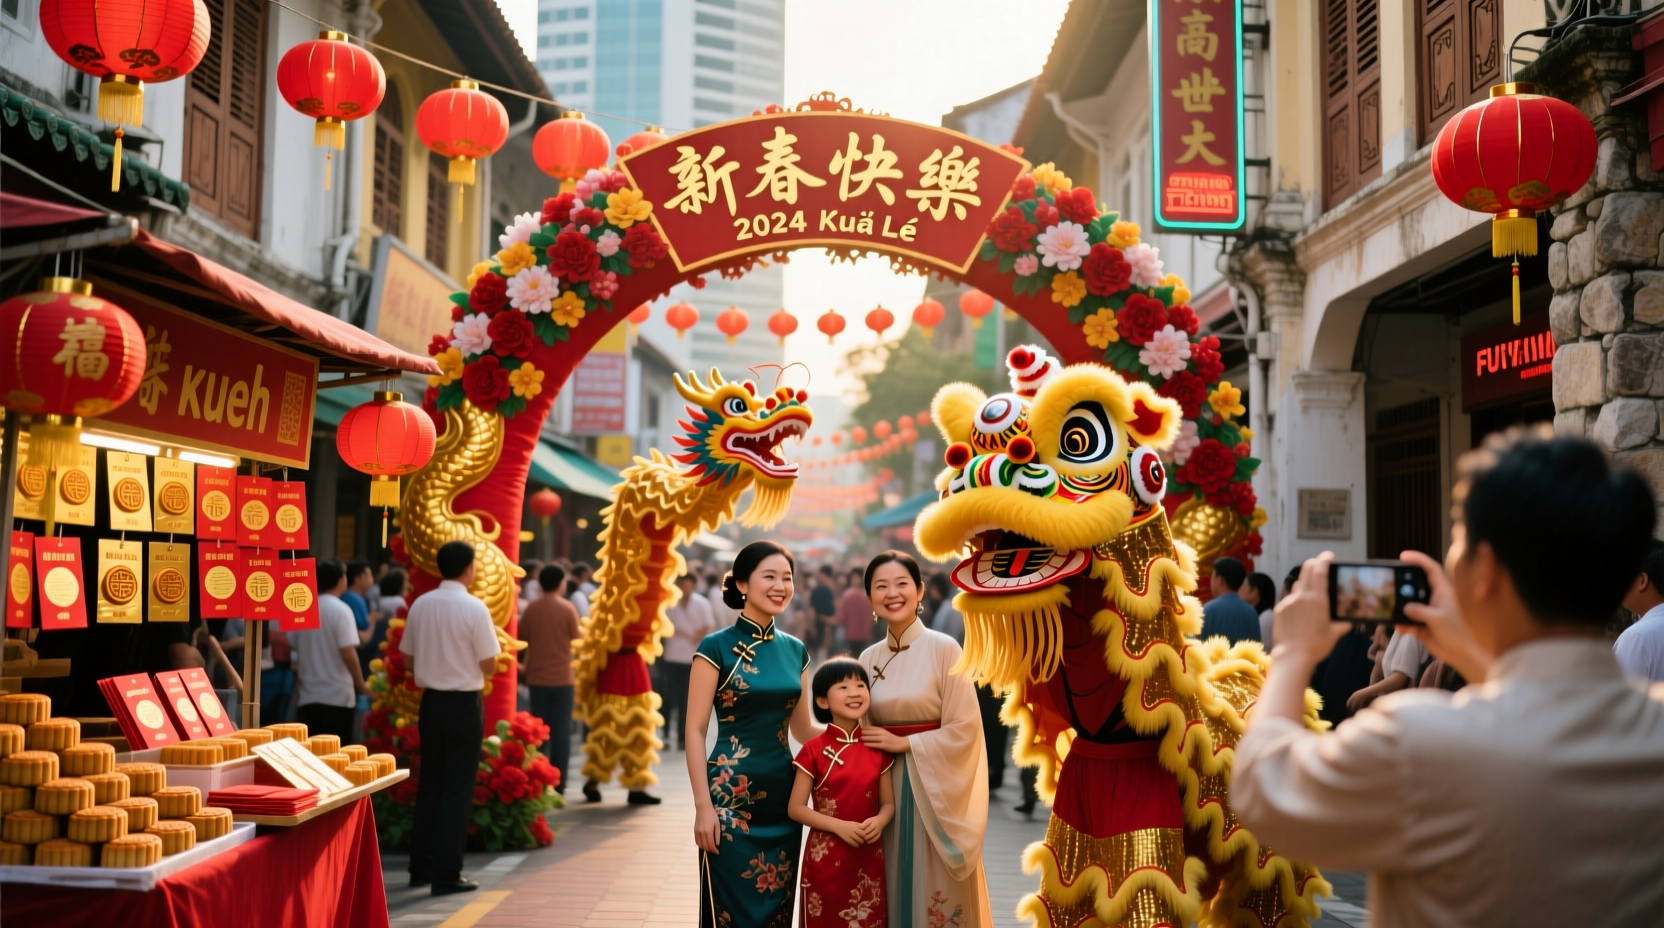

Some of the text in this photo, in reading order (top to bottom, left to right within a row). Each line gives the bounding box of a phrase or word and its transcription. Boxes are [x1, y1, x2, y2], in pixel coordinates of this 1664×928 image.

[1171, 0, 1227, 166] 高世大
[663, 126, 982, 221] 新春快樂
[733, 210, 807, 240] 2024
[881, 216, 919, 242] Lé
[53, 317, 110, 381] 福
